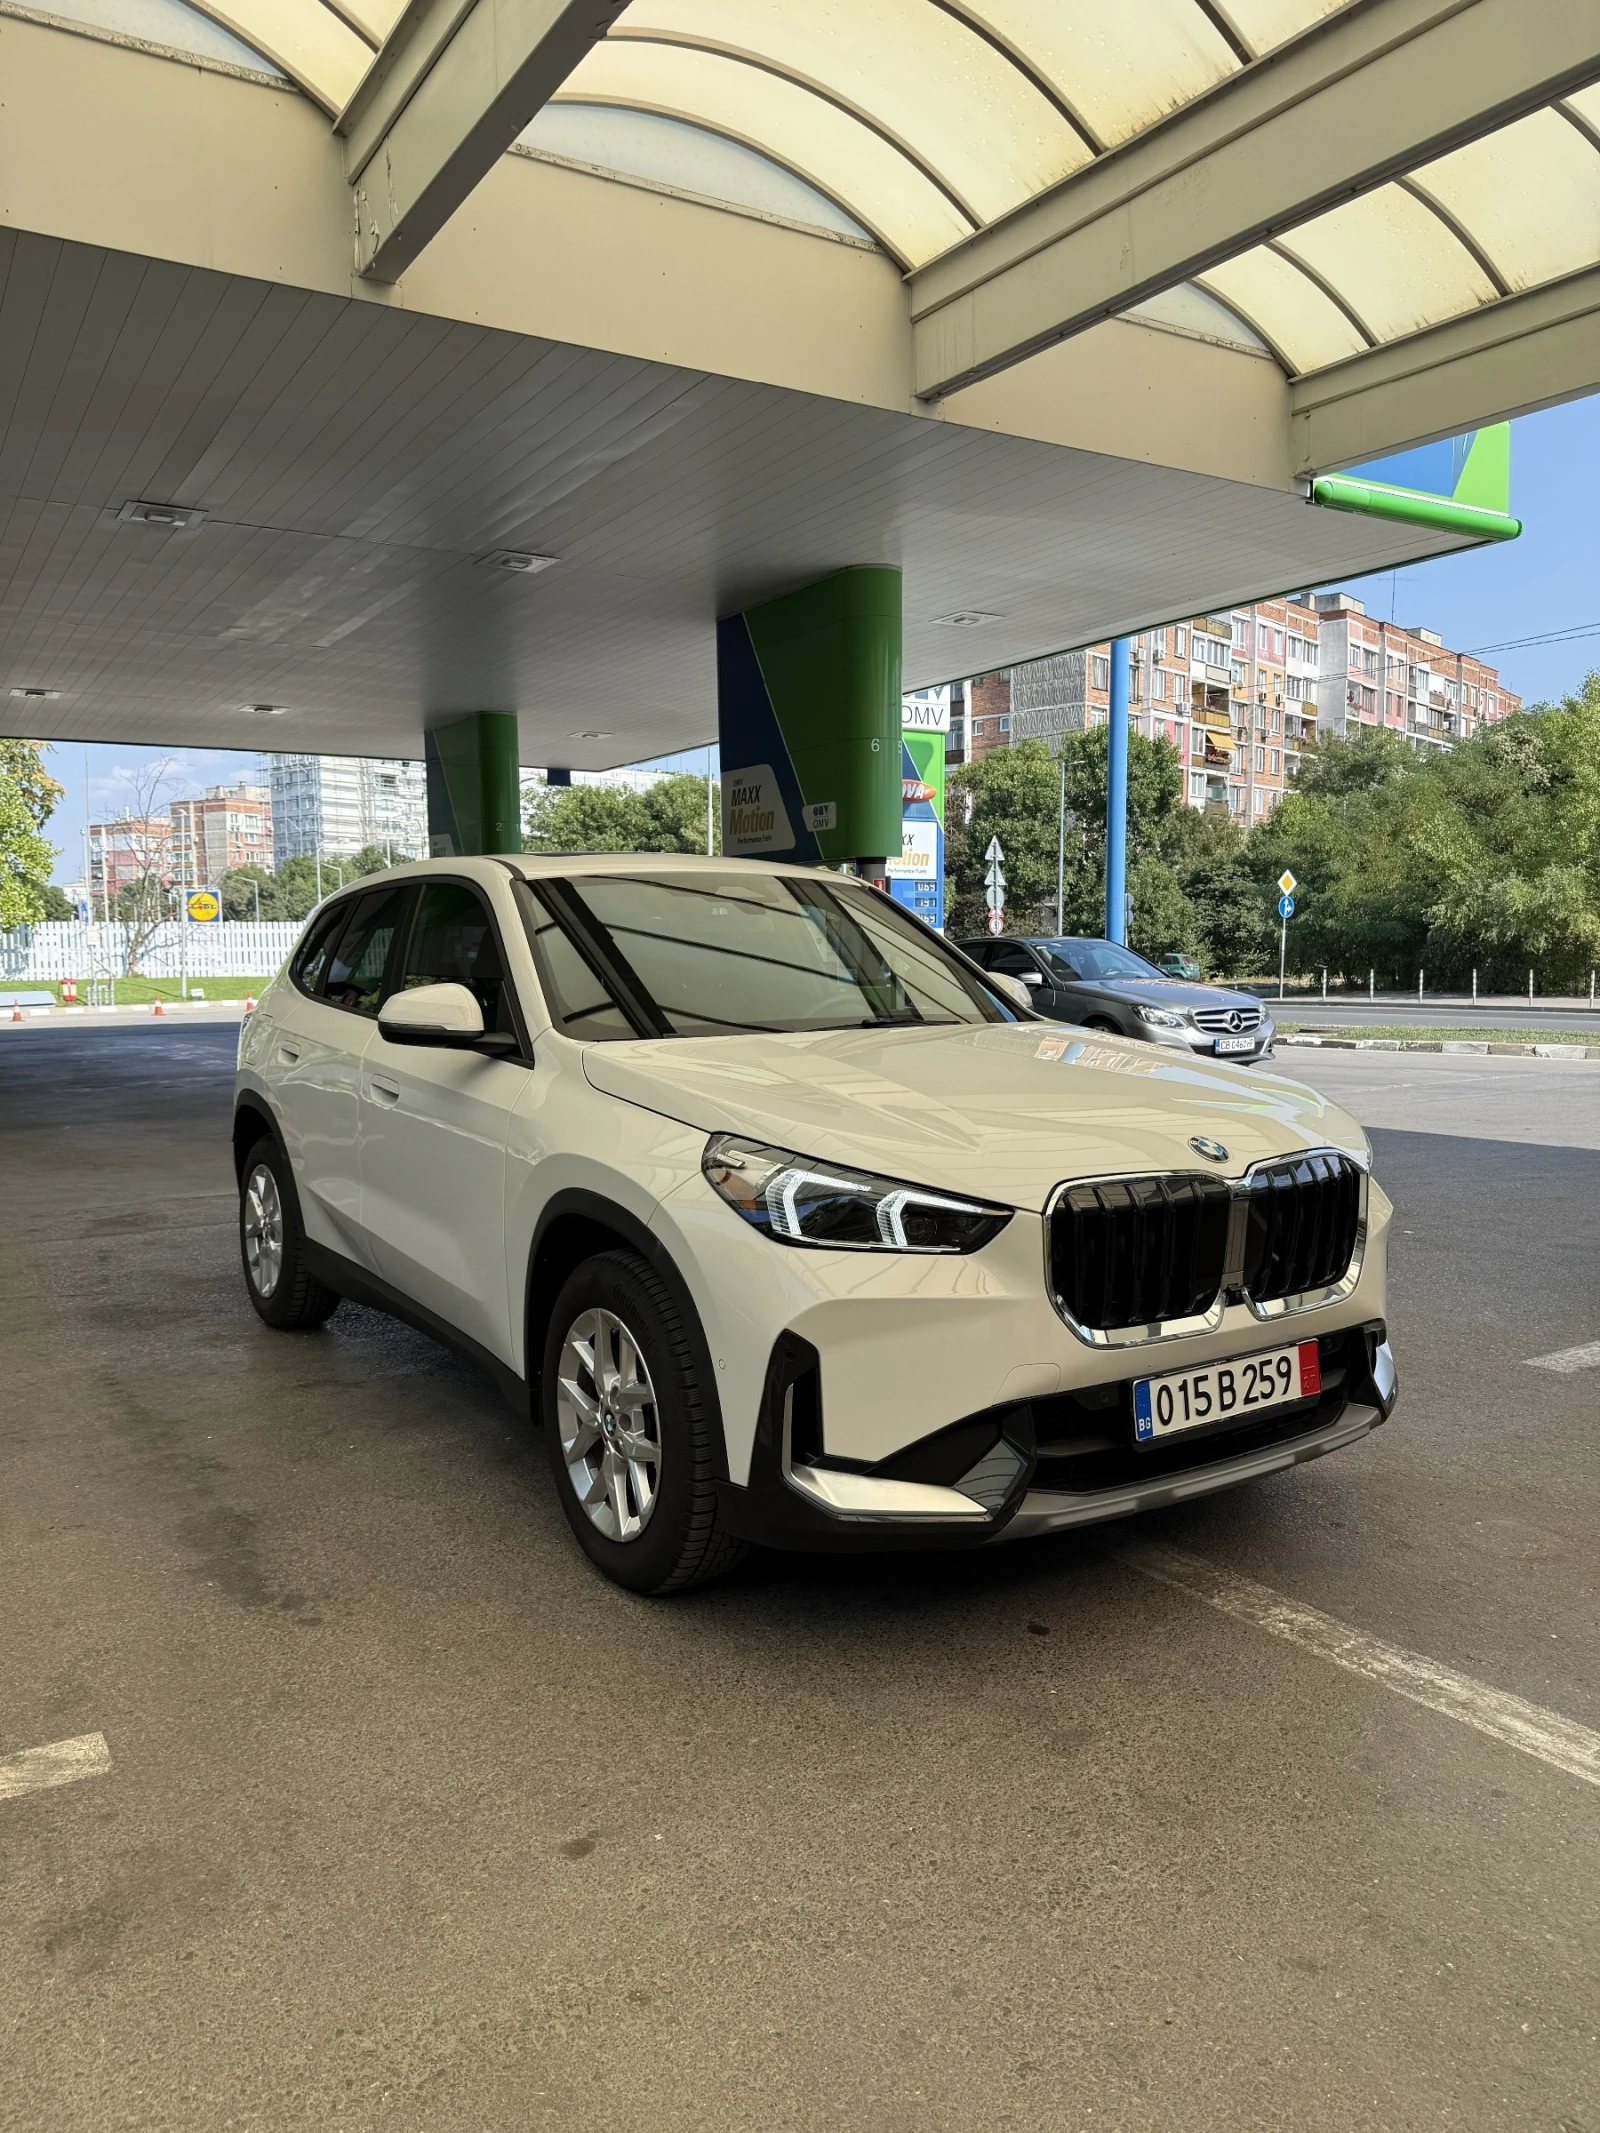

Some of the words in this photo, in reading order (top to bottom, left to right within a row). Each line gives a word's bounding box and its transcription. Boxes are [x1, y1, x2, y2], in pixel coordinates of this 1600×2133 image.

[871, 738, 880, 752] 6
[731, 785, 762, 807] MAXX
[496, 822, 502, 832] 2
[729, 805, 775, 836] Motion
[813, 818, 830, 829] OMV
[1138, 1416, 1151, 1432] BG
